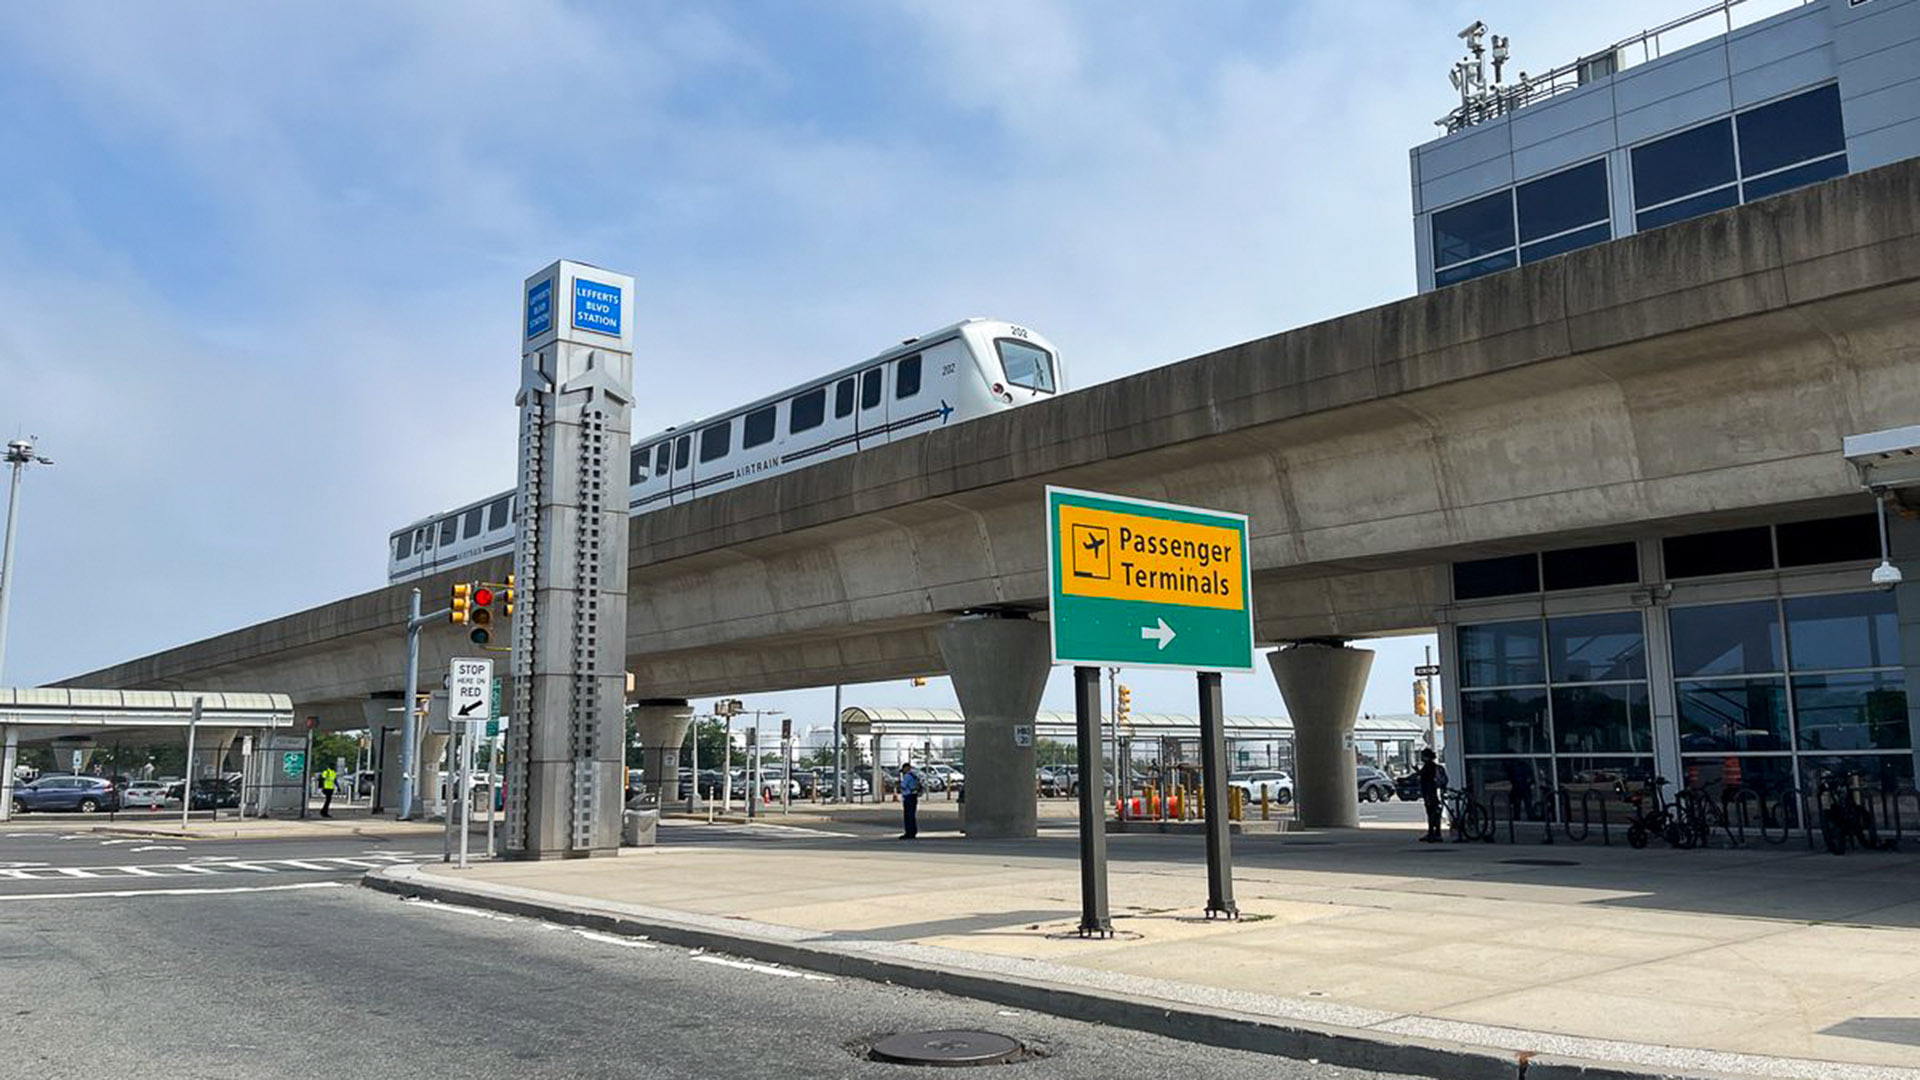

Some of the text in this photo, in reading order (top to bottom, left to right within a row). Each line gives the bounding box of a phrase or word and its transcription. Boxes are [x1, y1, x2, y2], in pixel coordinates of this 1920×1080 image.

[576, 287, 619, 304] LEFFERTS
[586, 301, 610, 313] BLVD
[577, 311, 617, 327] STATION
[1010, 325, 1028, 338] 202
[735, 456, 779, 479] AIRTRAIN
[1119, 527, 1231, 567] Passenger
[1121, 562, 1229, 596] Terminals
[458, 664, 486, 675] STOP
[476, 677, 486, 685] ON
[460, 687, 481, 697] RED
